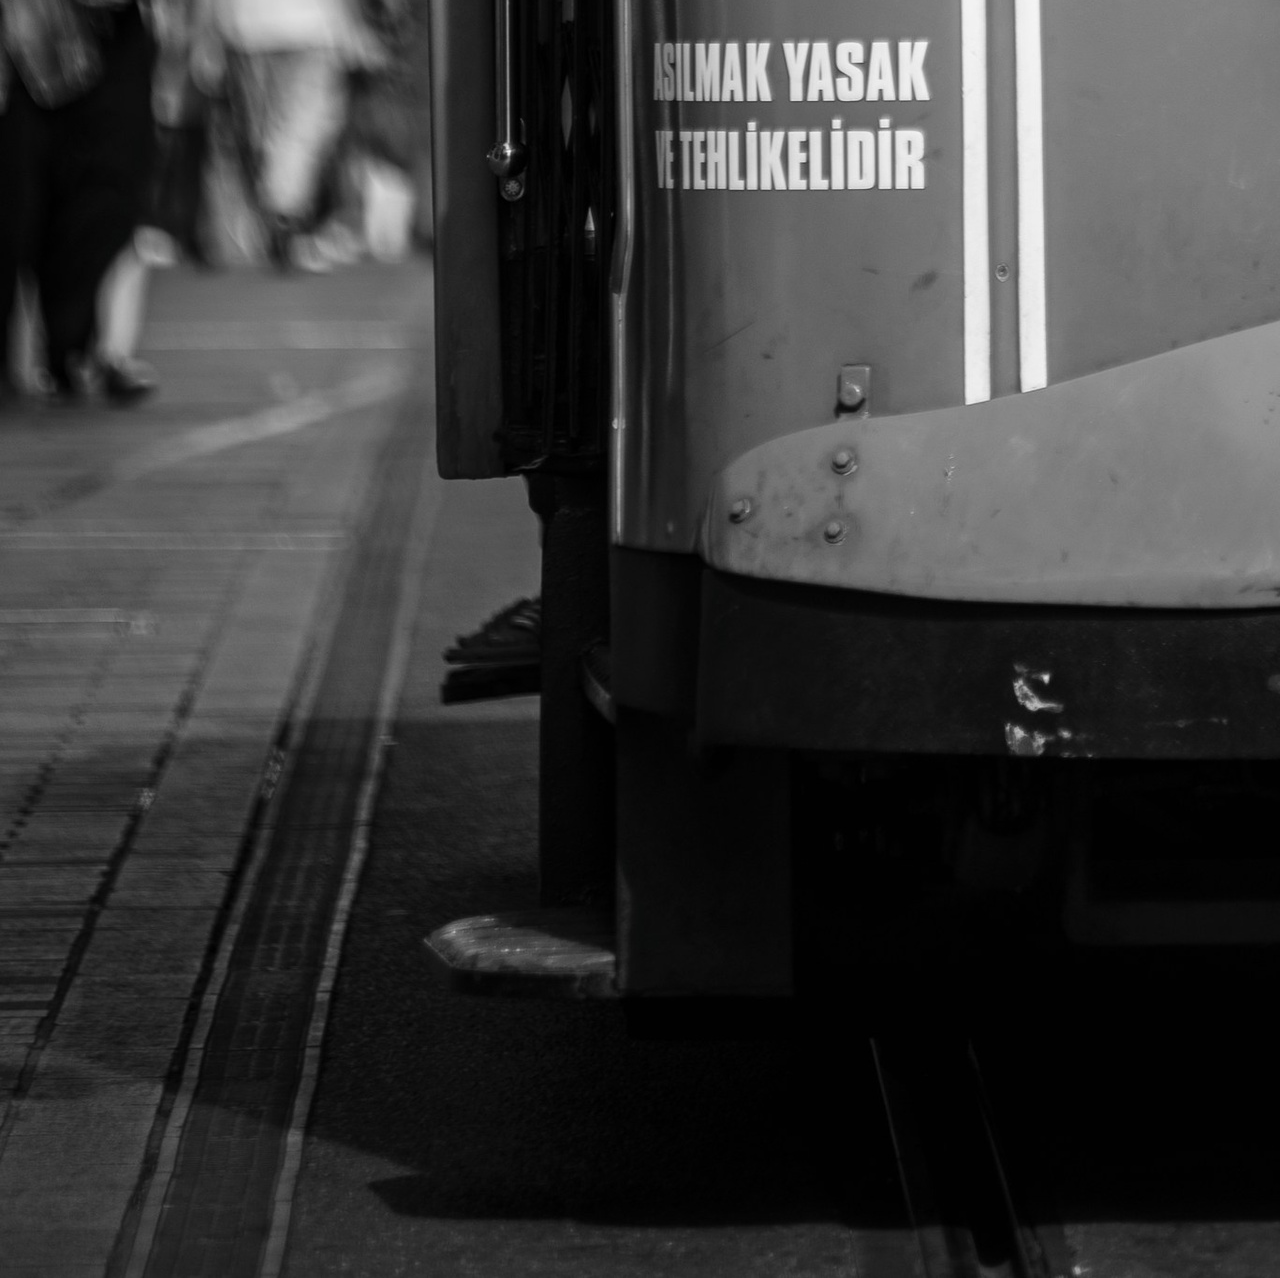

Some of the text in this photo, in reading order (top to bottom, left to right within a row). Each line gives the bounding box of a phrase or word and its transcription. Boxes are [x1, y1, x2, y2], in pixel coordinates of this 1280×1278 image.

[653, 40, 930, 102] ASILMAK YASAK
[655, 119, 925, 191] VE TEHLİKELİDİR
